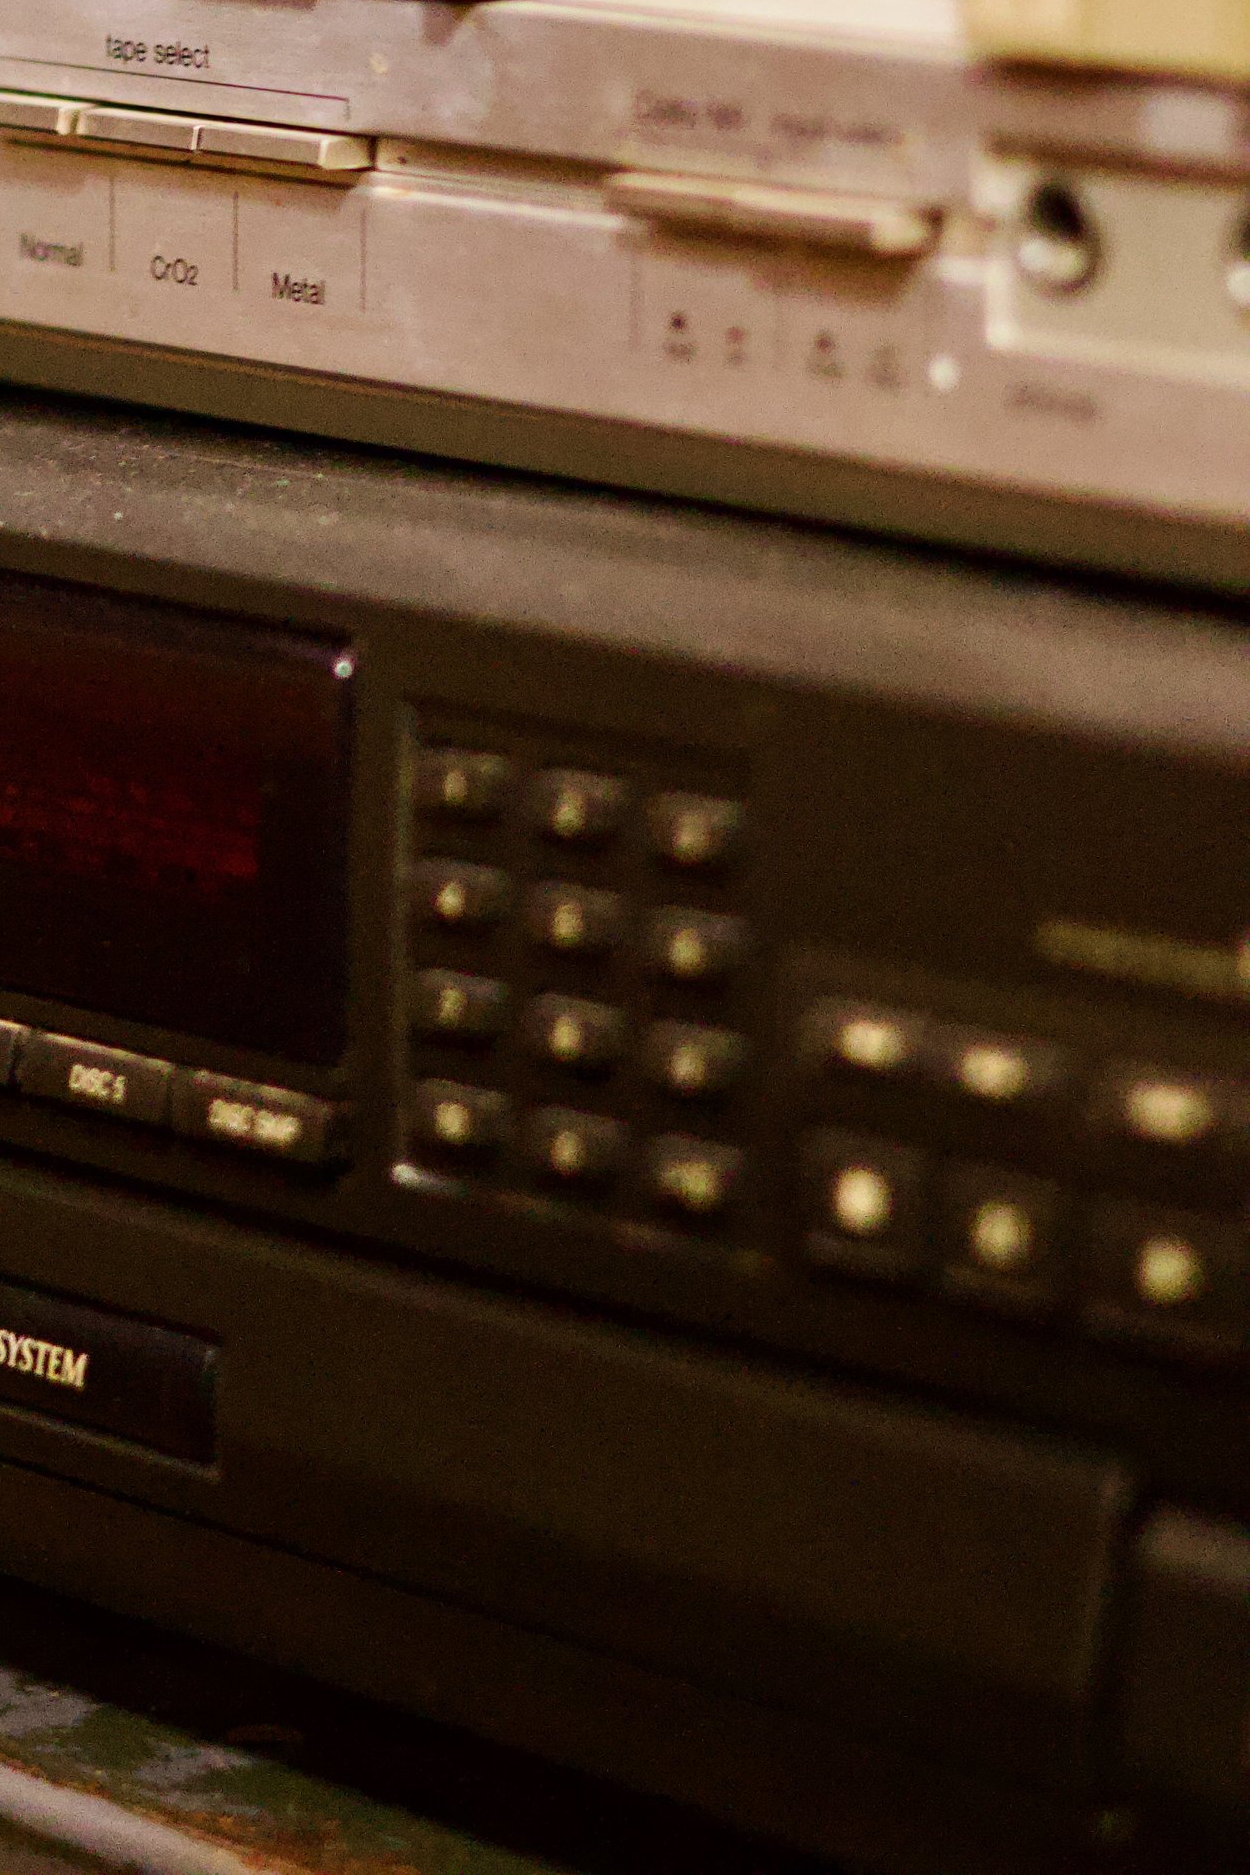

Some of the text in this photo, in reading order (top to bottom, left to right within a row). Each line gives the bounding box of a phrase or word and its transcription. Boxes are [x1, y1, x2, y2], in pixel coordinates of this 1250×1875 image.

[105, 34, 210, 69] tape select
[19, 231, 84, 267] Normal
[271, 272, 326, 305] Metal
[68, 1063, 128, 1105] DISC 5
